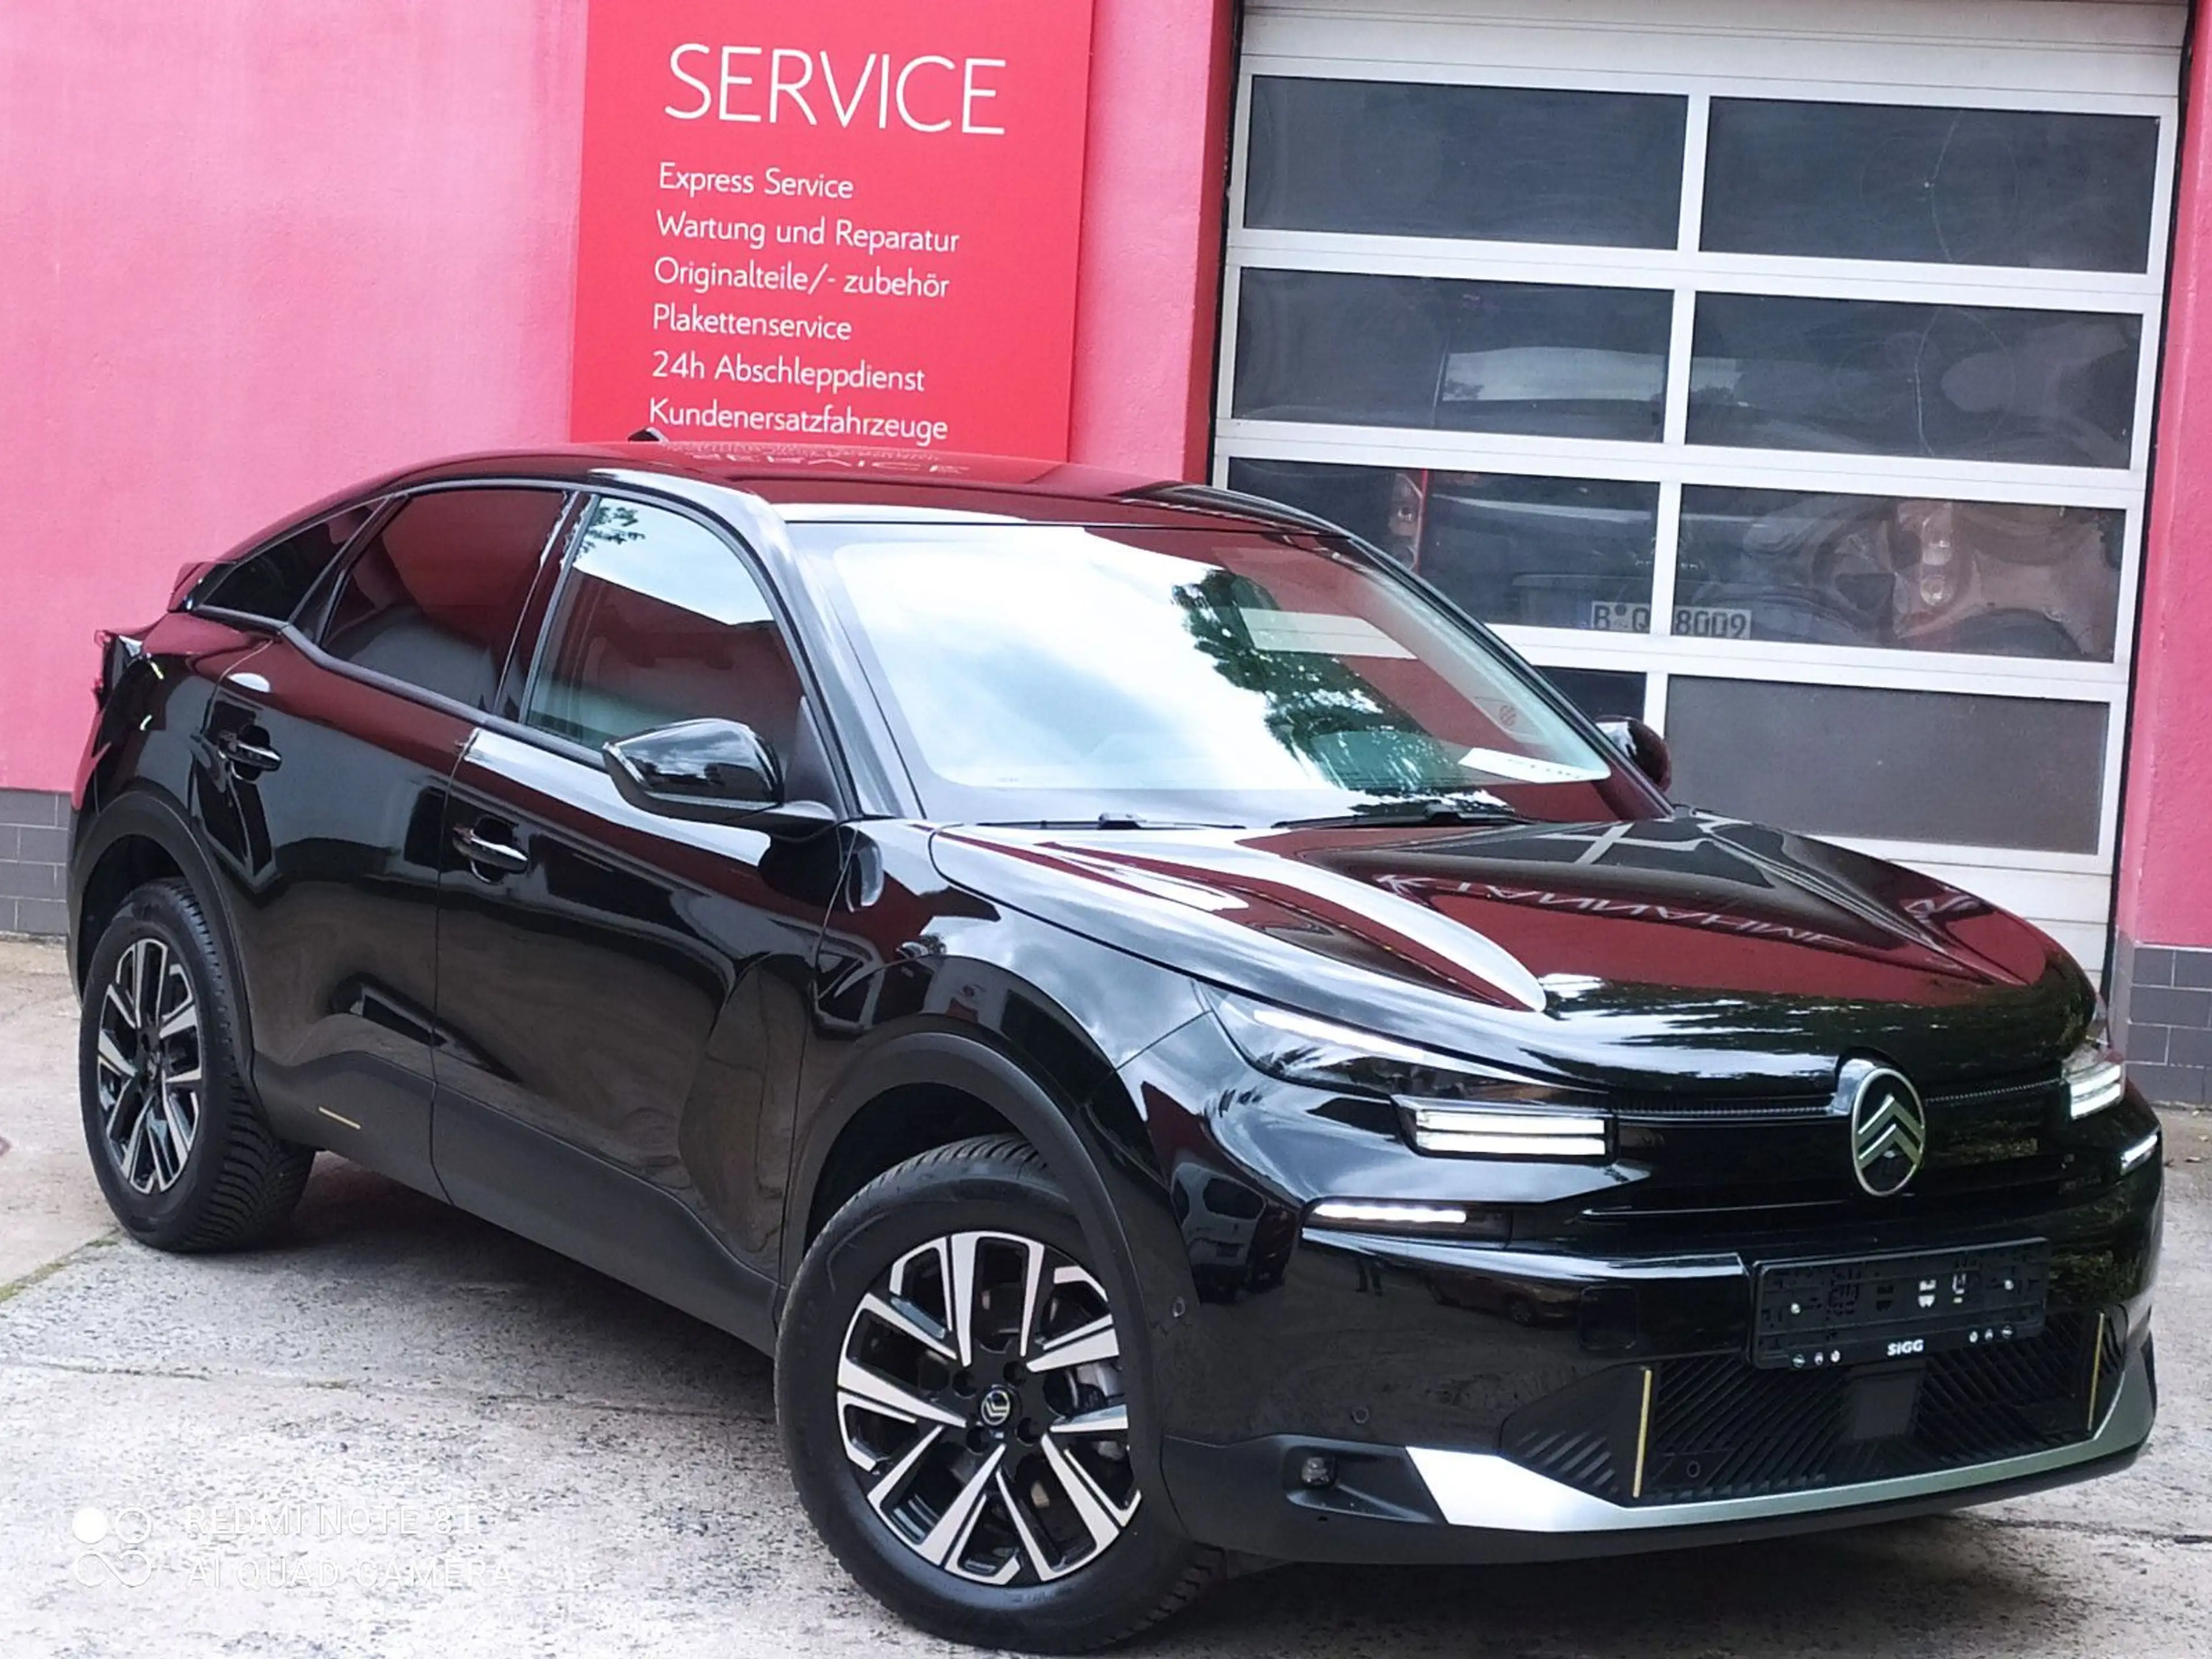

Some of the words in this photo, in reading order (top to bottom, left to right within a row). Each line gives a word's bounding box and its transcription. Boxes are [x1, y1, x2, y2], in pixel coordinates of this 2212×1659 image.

[664, 43, 1006, 135] SERVICE
[659, 162, 754, 198] Express
[764, 167, 854, 199] Service
[656, 209, 766, 249] Wartung
[777, 216, 825, 245] und
[836, 219, 960, 255] Reparatur
[654, 256, 836, 295] Originalteile/-
[843, 266, 950, 298] zubehör
[653, 304, 853, 340] Plakettenservice
[652, 350, 706, 380] 24h
[714, 353, 926, 392] Abschleppdienst
[649, 397, 949, 446] Kundenersatzfahrzeuge
[1594, 605, 1611, 631] B
